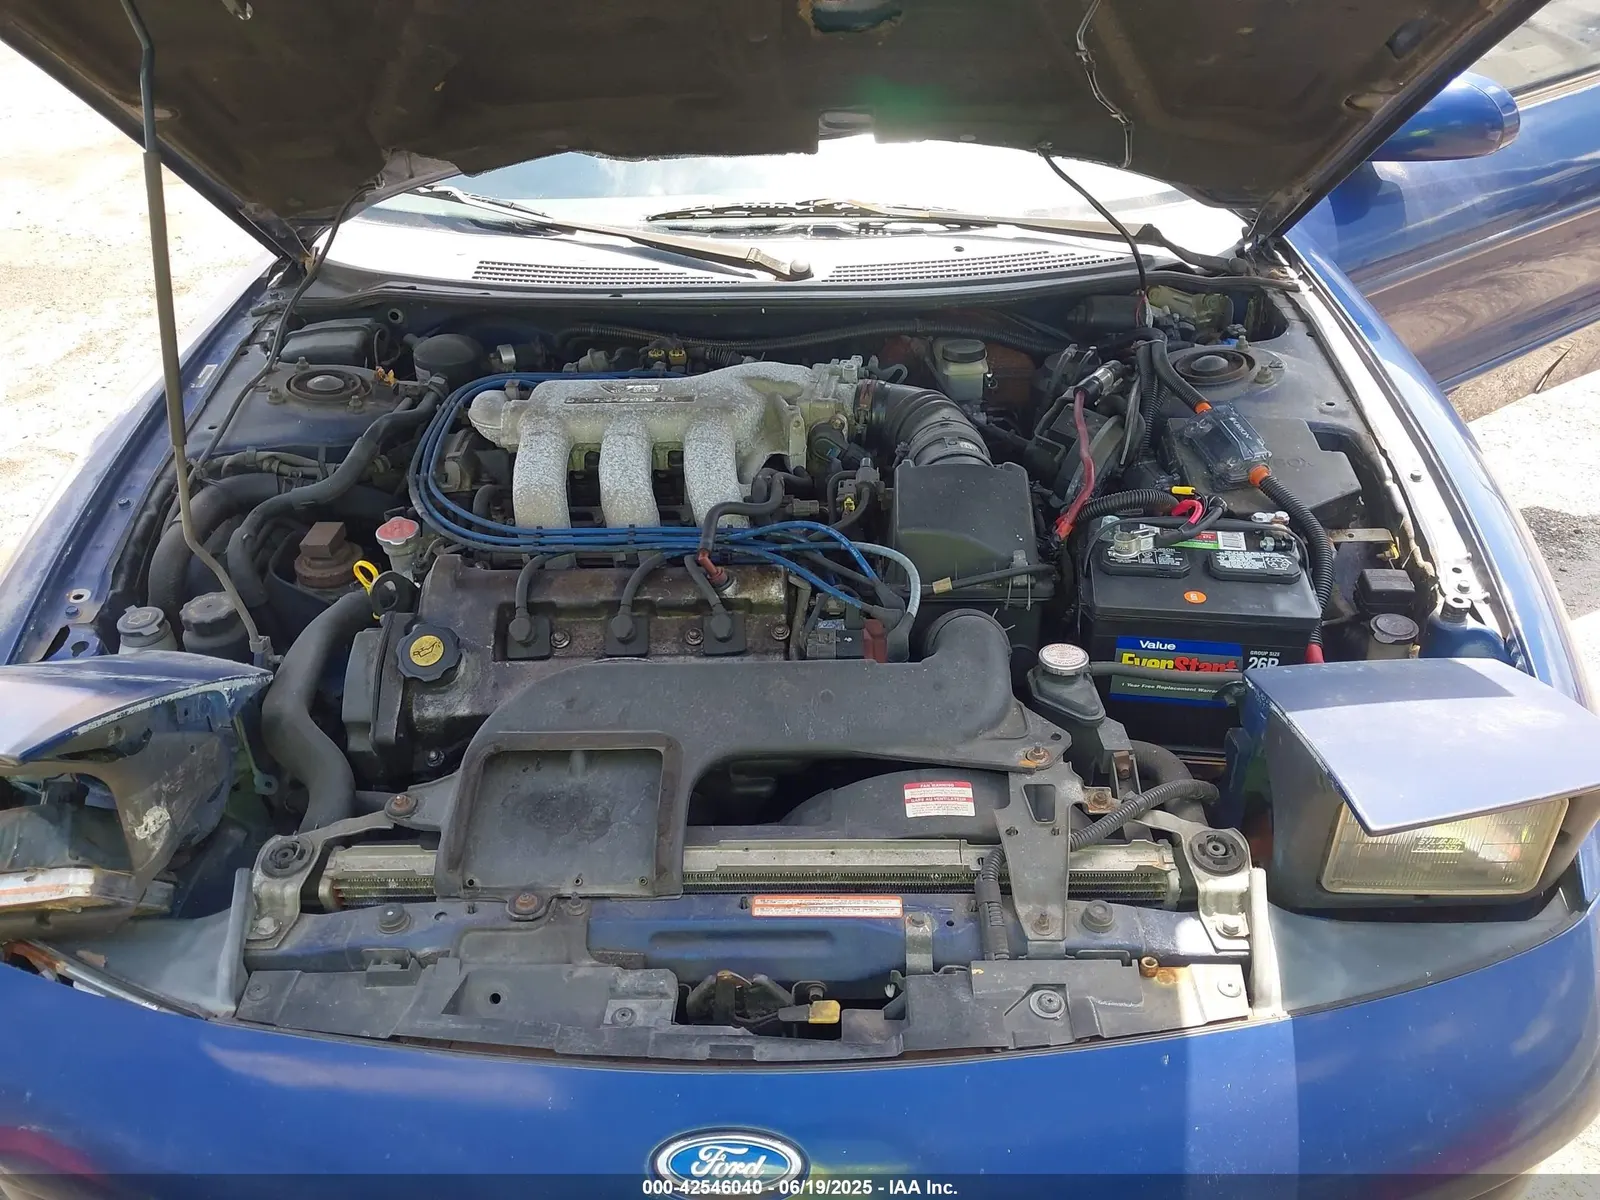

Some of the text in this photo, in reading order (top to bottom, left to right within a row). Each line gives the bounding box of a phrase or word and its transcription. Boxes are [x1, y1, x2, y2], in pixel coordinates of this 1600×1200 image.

[1139, 639, 1176, 651] Value
[1156, 684, 1197, 692] Replacement
[690, 1145, 767, 1179] Ford
